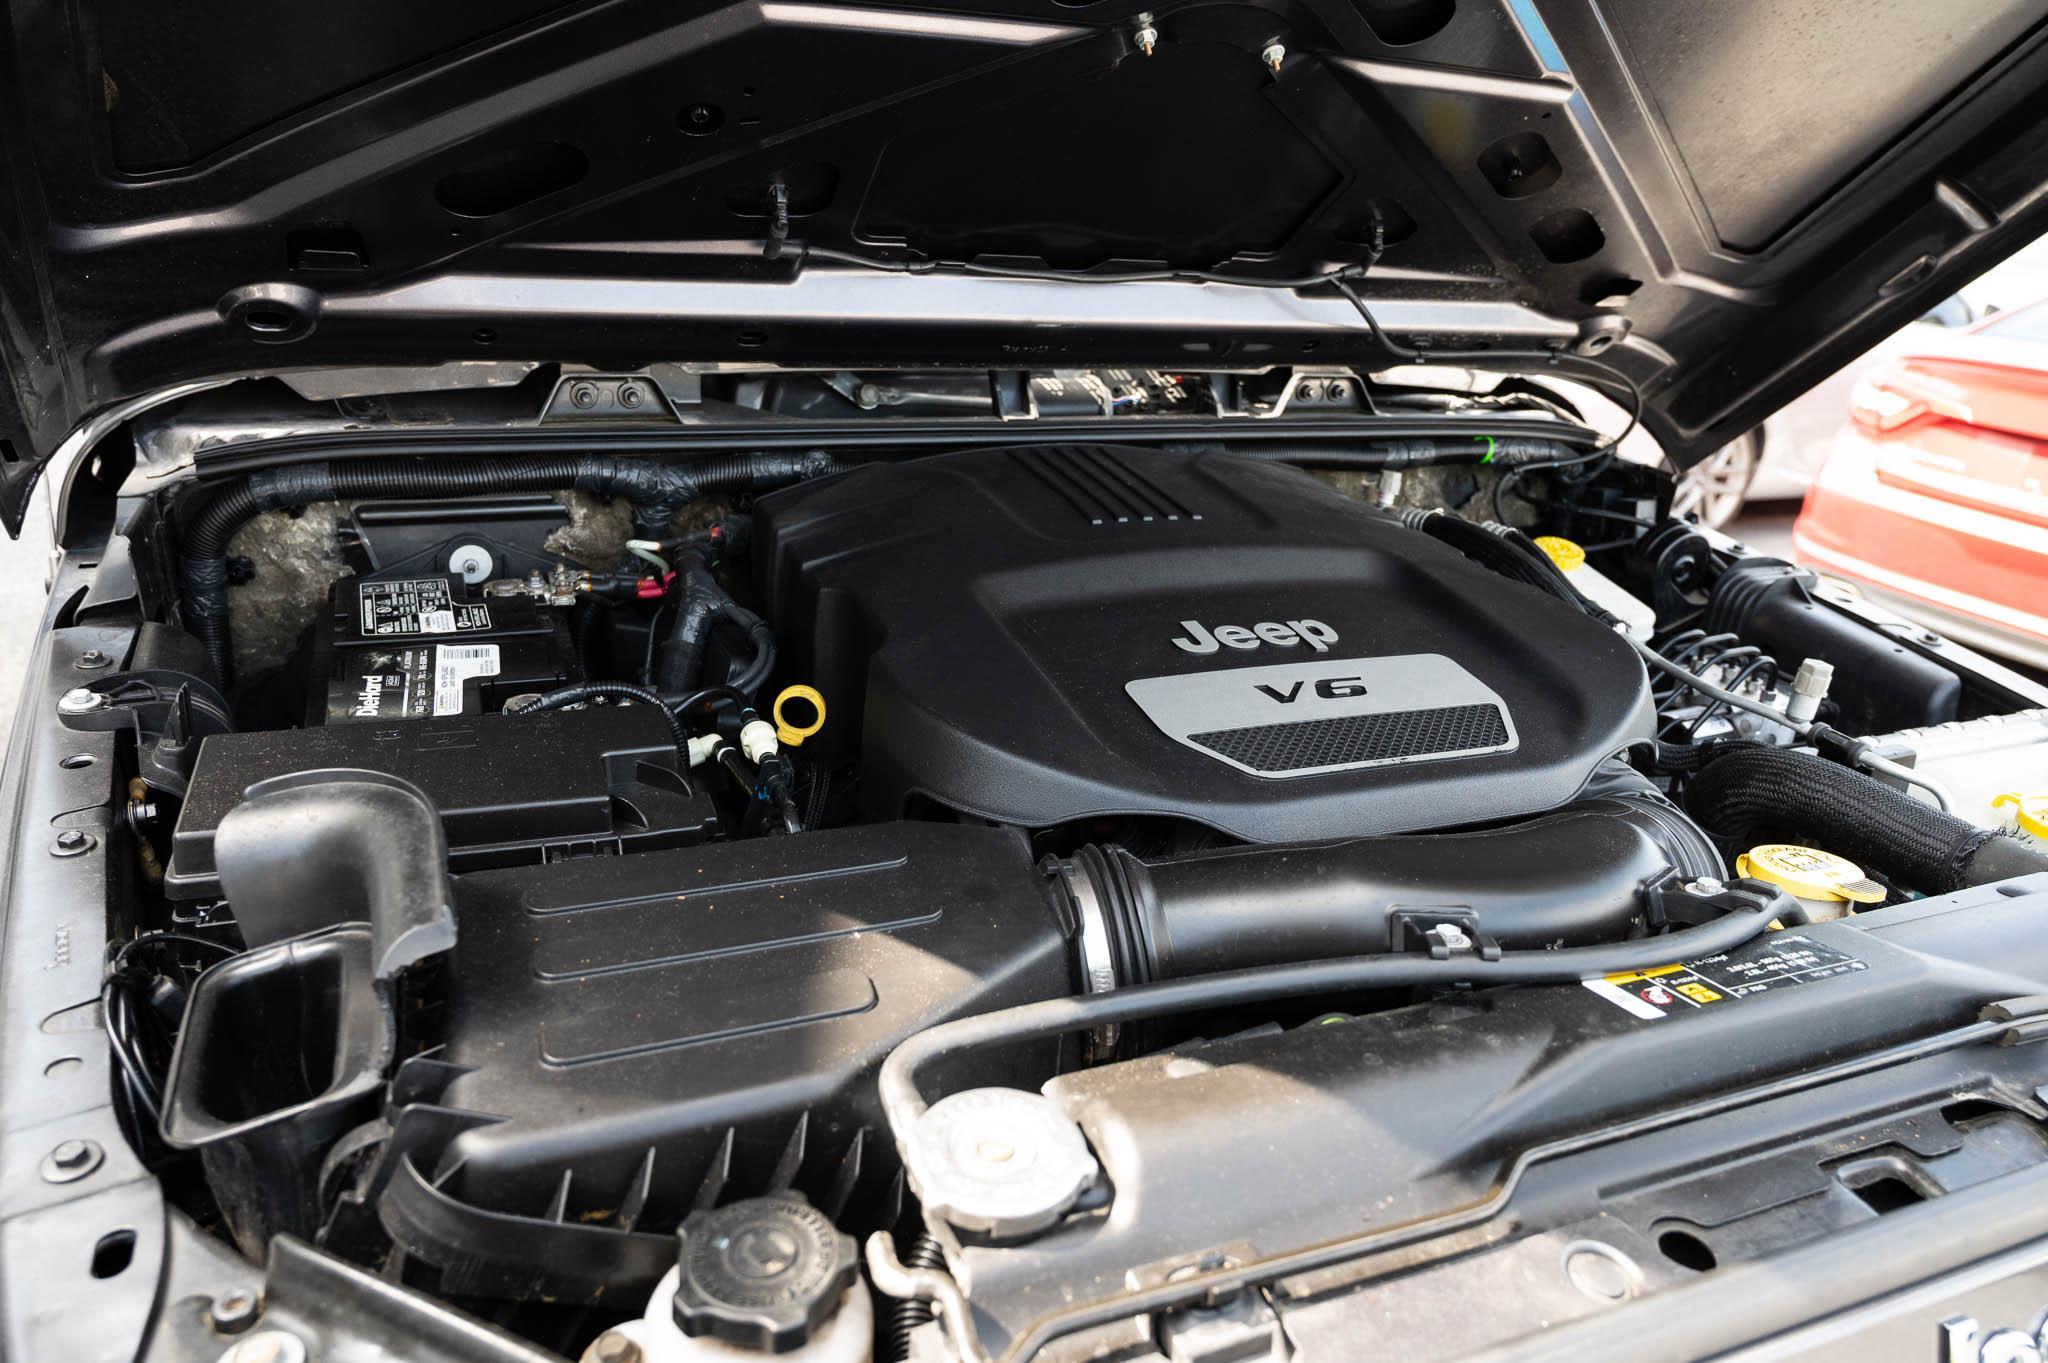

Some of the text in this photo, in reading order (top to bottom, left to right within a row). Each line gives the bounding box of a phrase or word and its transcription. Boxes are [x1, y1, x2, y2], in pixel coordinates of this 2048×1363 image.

[1171, 619, 1340, 654] Jeep
[355, 675, 383, 717] DieHard
[1253, 676, 1368, 705] V6
